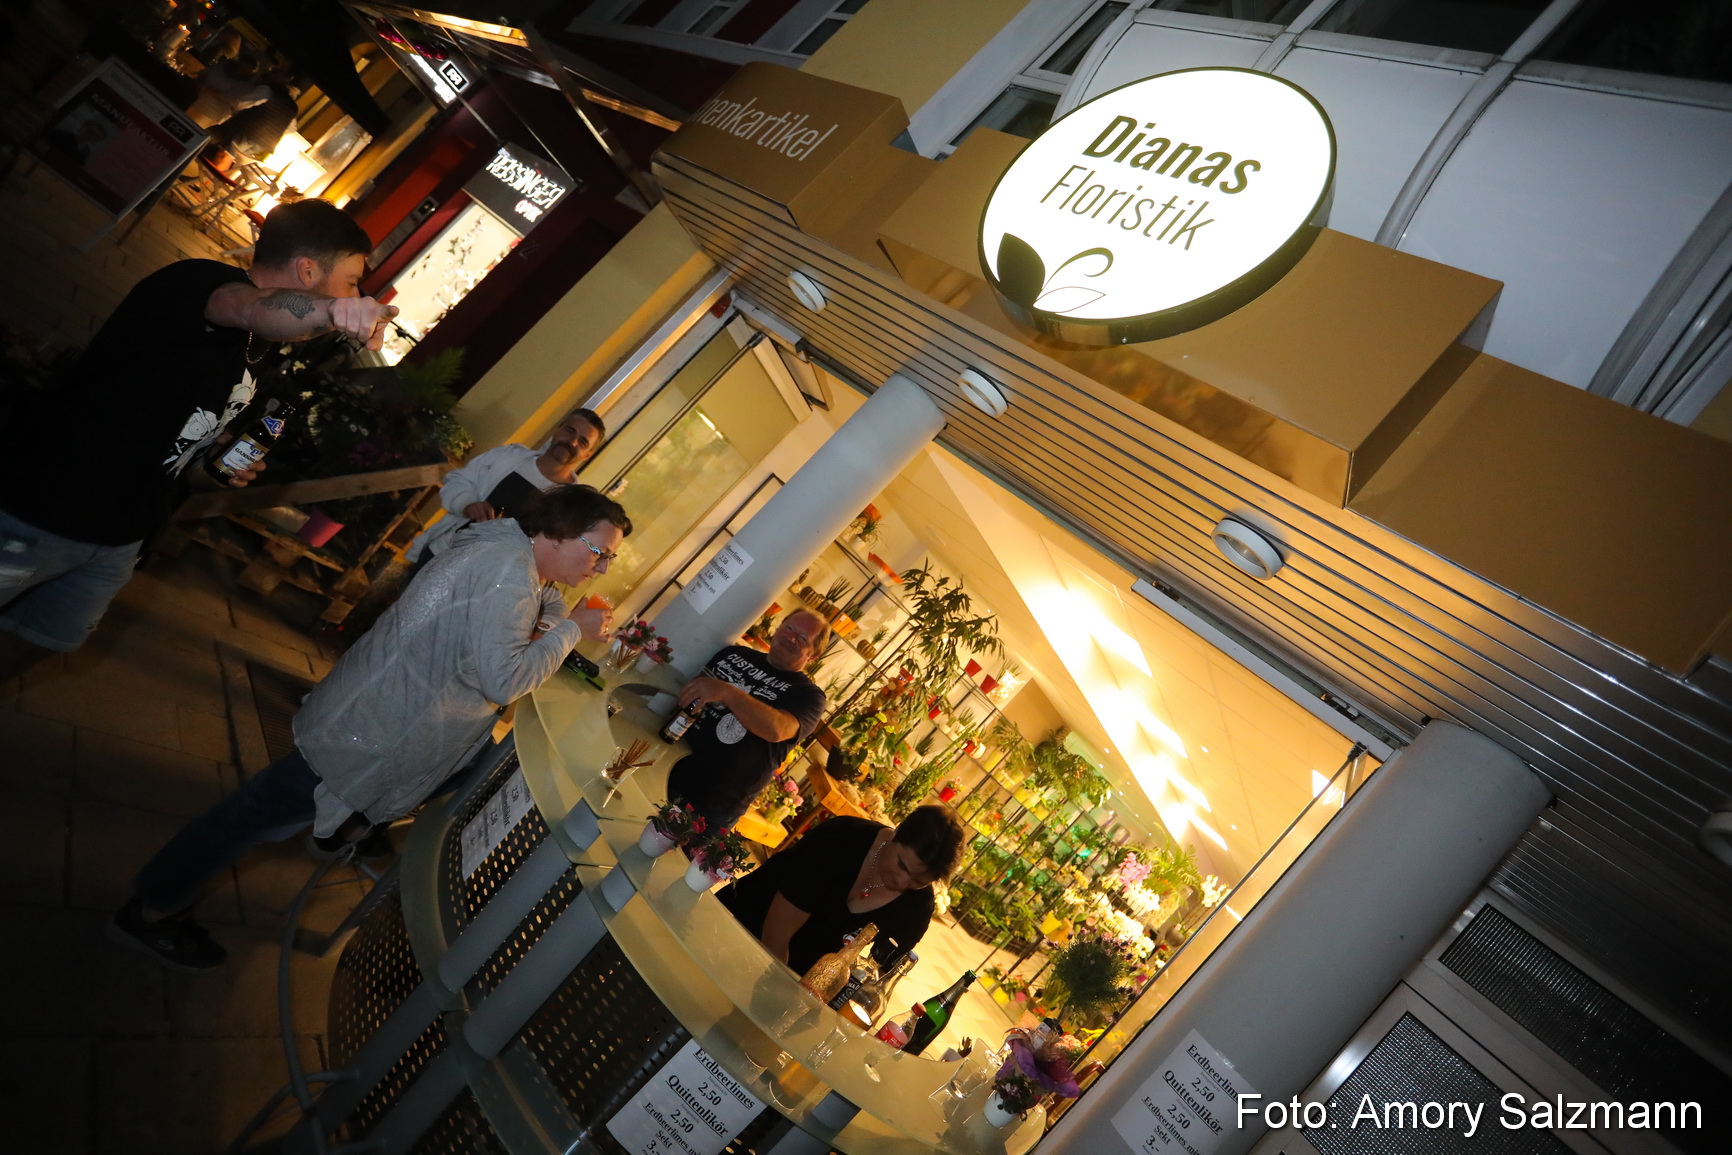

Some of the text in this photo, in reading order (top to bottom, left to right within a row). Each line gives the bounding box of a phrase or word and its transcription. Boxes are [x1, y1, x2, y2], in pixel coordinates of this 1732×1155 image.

[91, 93, 170, 157] MANUFAKTUR
[1082, 115, 1261, 195] Dianas
[1040, 164, 1215, 251] Floristik
[694, 1047, 755, 1109] Erdbeerlimes
[697, 1082, 722, 1106] 2,50
[1187, 1044, 1246, 1106] Erdbeerlim
[1192, 1077, 1215, 1102] 2,50
[644, 1102, 689, 1150] Erdbeerlimes
[668, 1074, 729, 1136] Quittenlikör
[670, 1109, 694, 1134] 2,50
[1143, 1096, 1188, 1147] Erdbeerlimes
[1163, 1070, 1224, 1135] Quittenlikör
[1167, 1104, 1191, 1129] 2,50
[656, 1130, 673, 1148] Sekt
[1145, 1135, 1160, 1152] 3.-
[1154, 1125, 1171, 1145] Sekt
